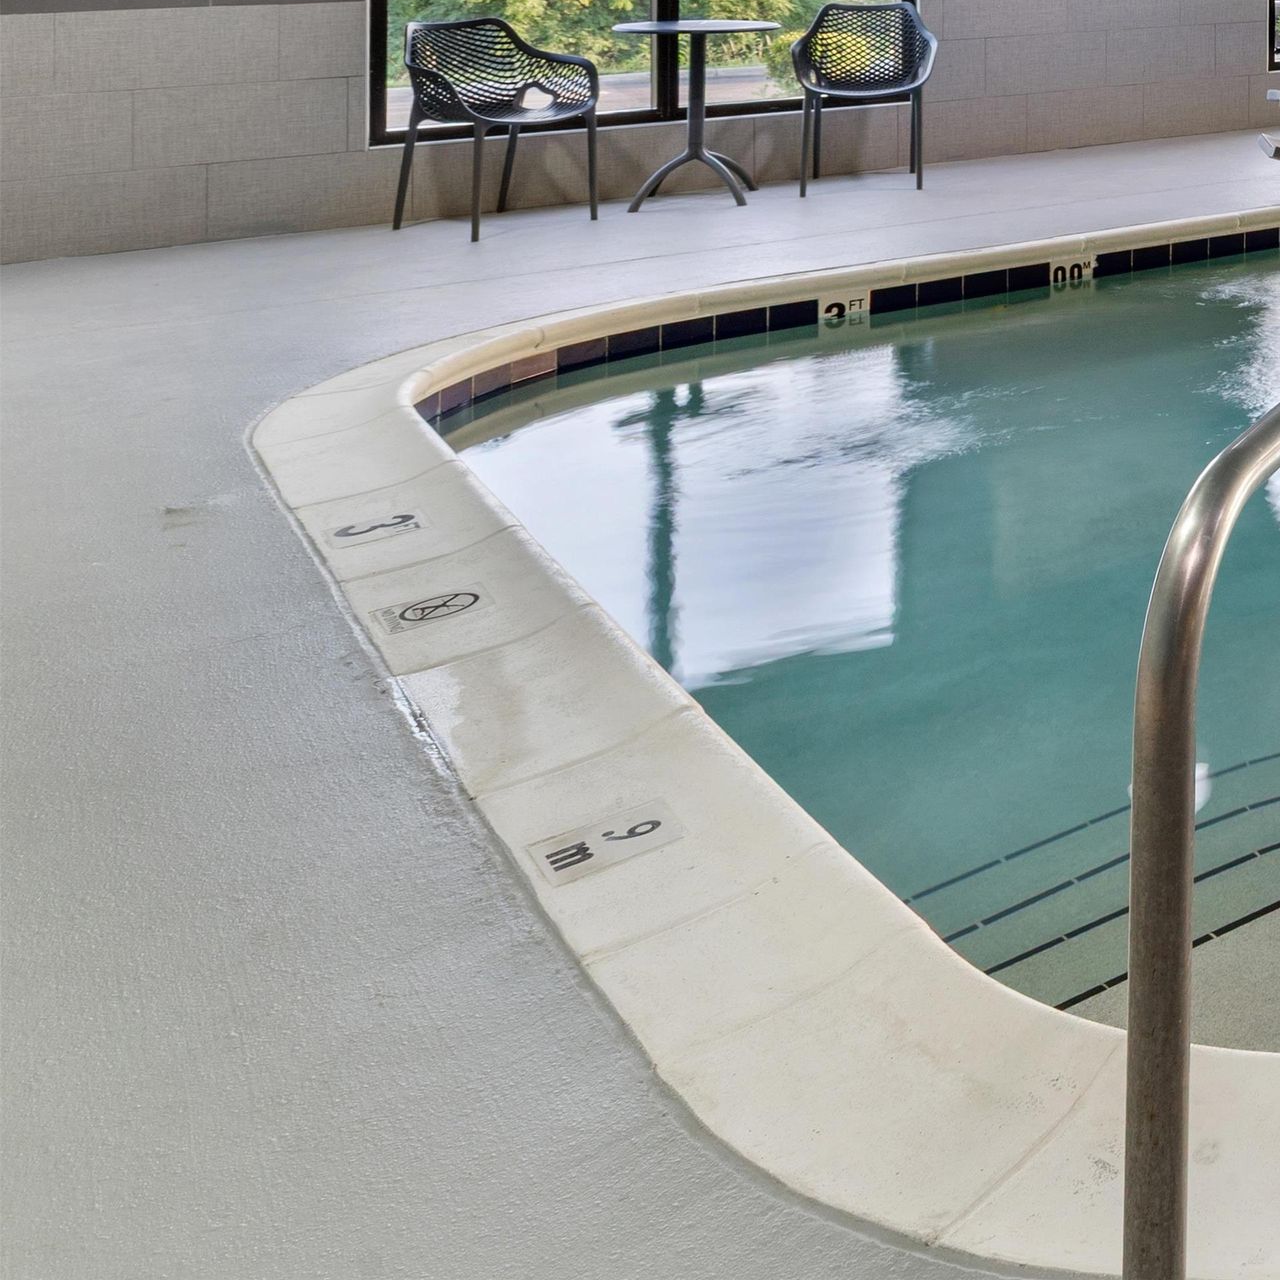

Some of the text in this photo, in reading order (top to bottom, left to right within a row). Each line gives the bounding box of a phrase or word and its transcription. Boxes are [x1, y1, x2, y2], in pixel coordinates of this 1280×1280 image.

[824, 298, 865, 319] 3 FT
[334, 514, 415, 537] 3
[545, 840, 595, 872] m
